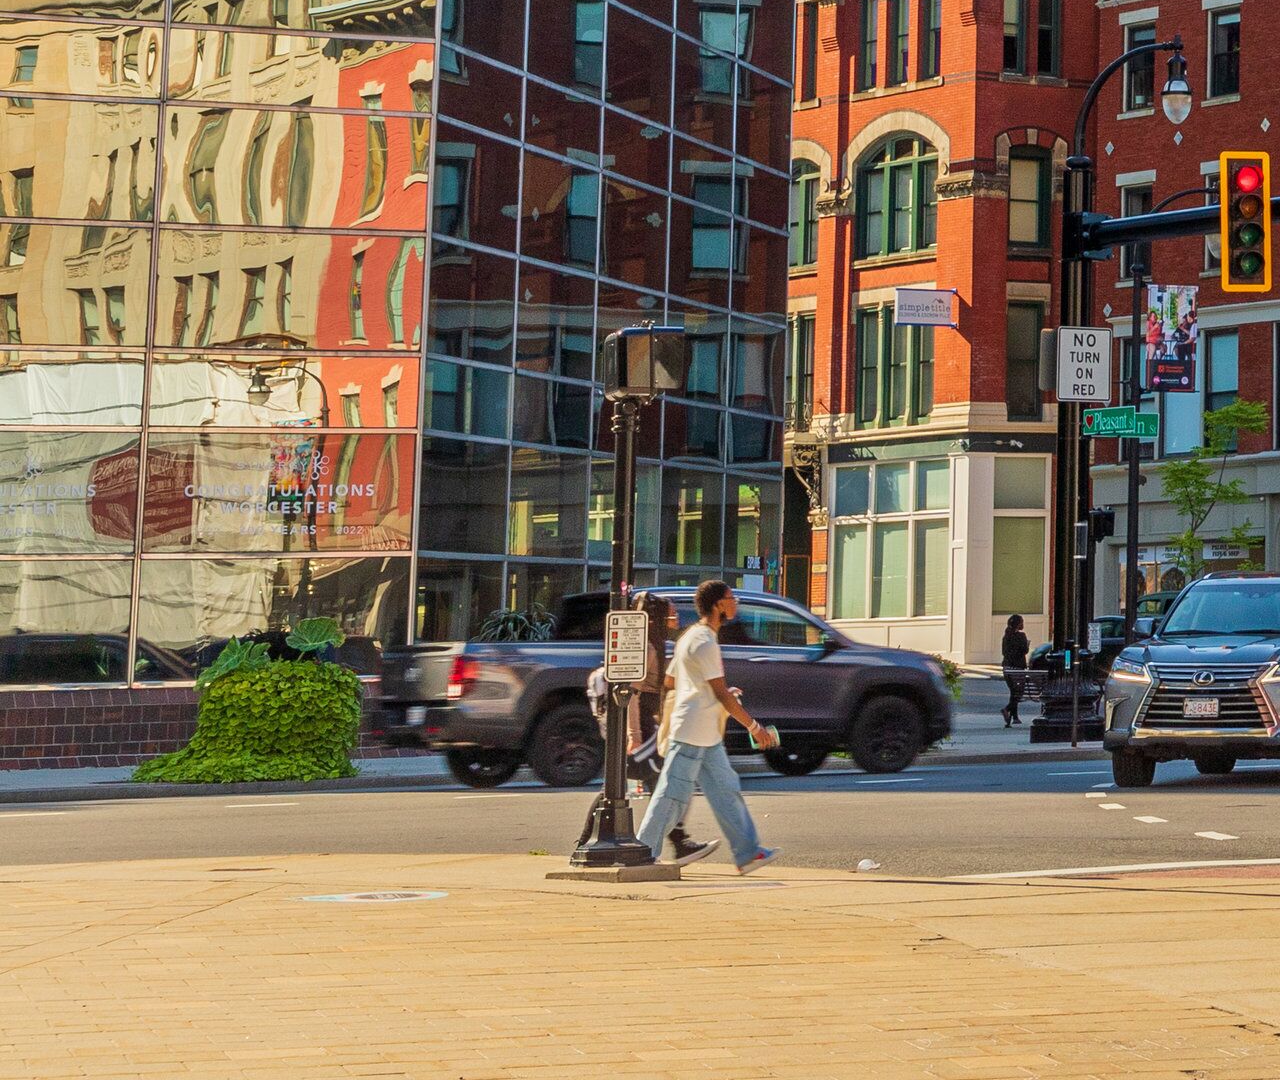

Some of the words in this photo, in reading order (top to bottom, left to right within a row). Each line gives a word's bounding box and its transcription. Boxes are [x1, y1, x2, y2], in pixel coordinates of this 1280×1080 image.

[1073, 333, 1096, 348] NO
[1069, 351, 1100, 364] TURN
[1075, 367, 1093, 380] ON
[1072, 384, 1096, 396] RED
[1094, 412, 1127, 431] Pleasant
[220, 501, 339, 514] WORCESTER
